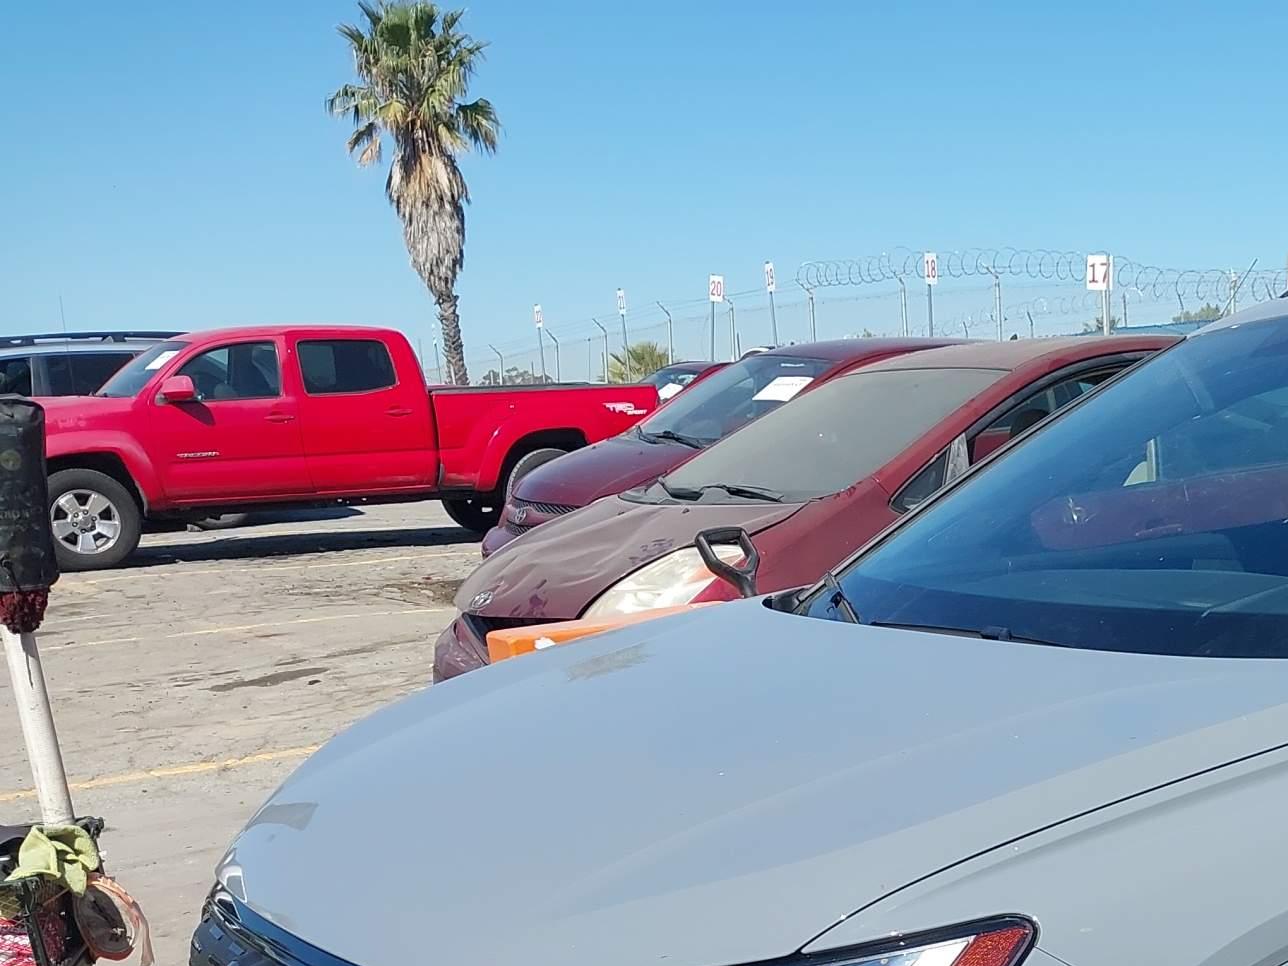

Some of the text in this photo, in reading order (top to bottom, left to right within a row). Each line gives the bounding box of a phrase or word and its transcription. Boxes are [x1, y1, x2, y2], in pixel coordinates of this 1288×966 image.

[765, 267, 775, 287] 19
[925, 258, 938, 279] 18
[1088, 262, 1111, 284] 17
[710, 280, 722, 297] 20
